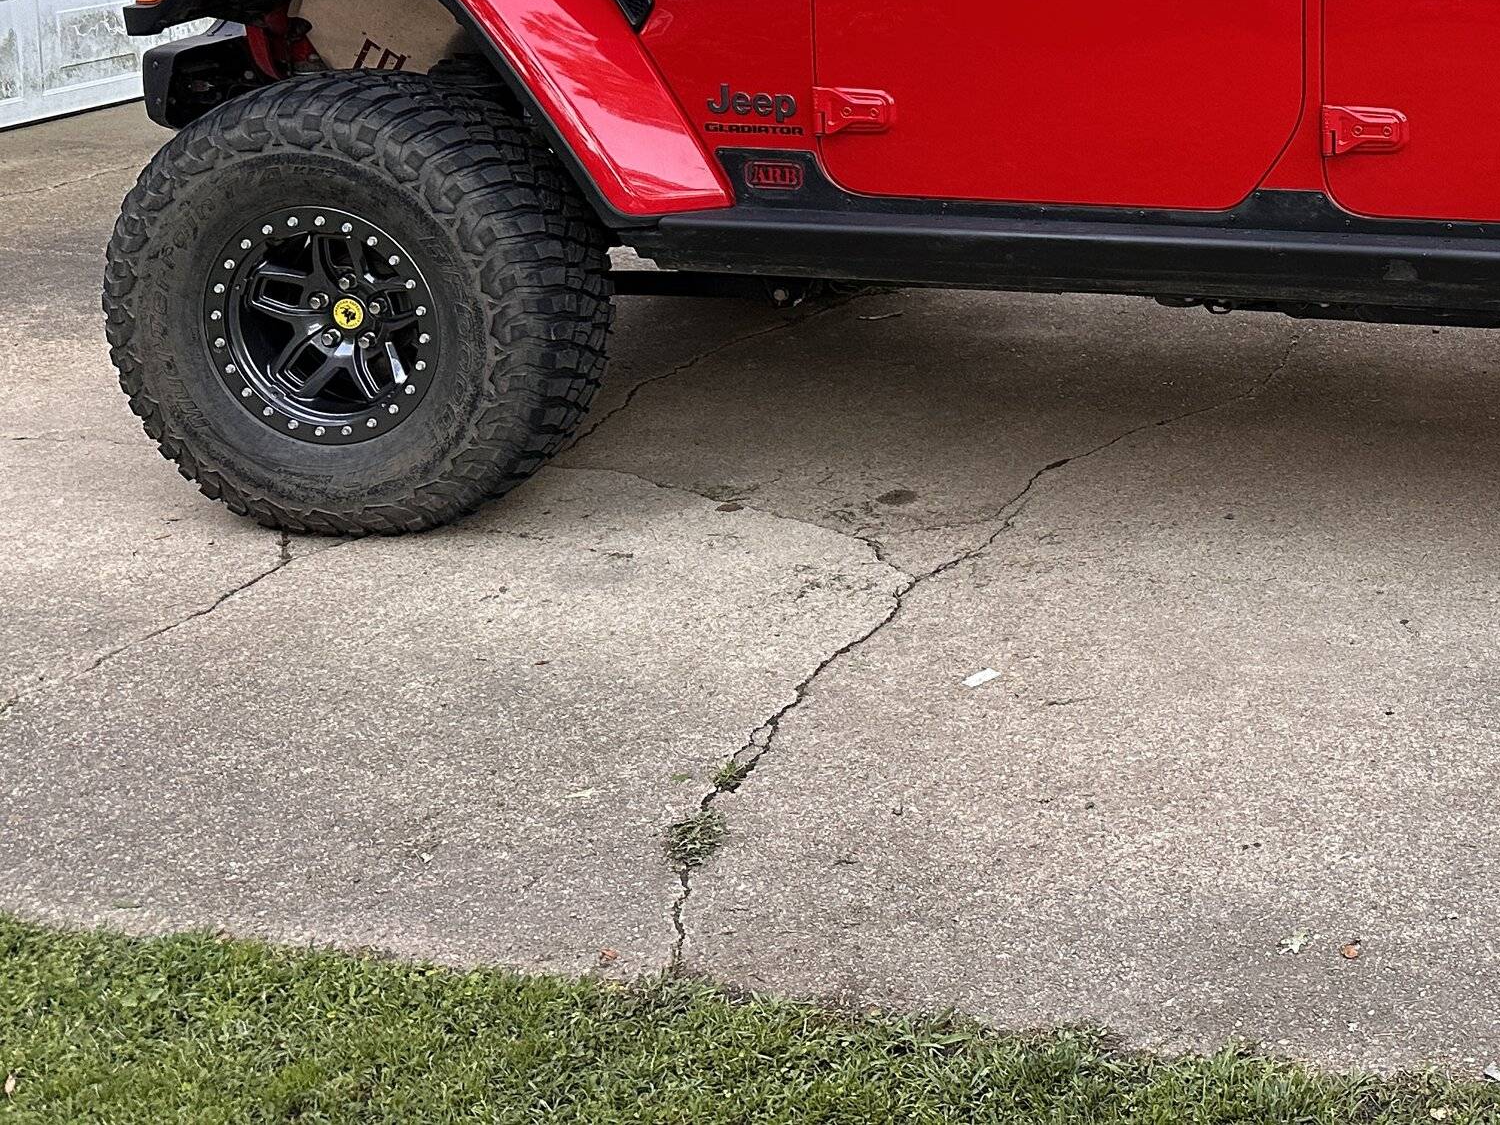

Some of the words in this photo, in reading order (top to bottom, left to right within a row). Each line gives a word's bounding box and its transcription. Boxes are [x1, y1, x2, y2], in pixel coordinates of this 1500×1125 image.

[707, 83, 796, 122] Jeep
[704, 123, 804, 135] GLADIATOR
[751, 164, 798, 185] ARB
